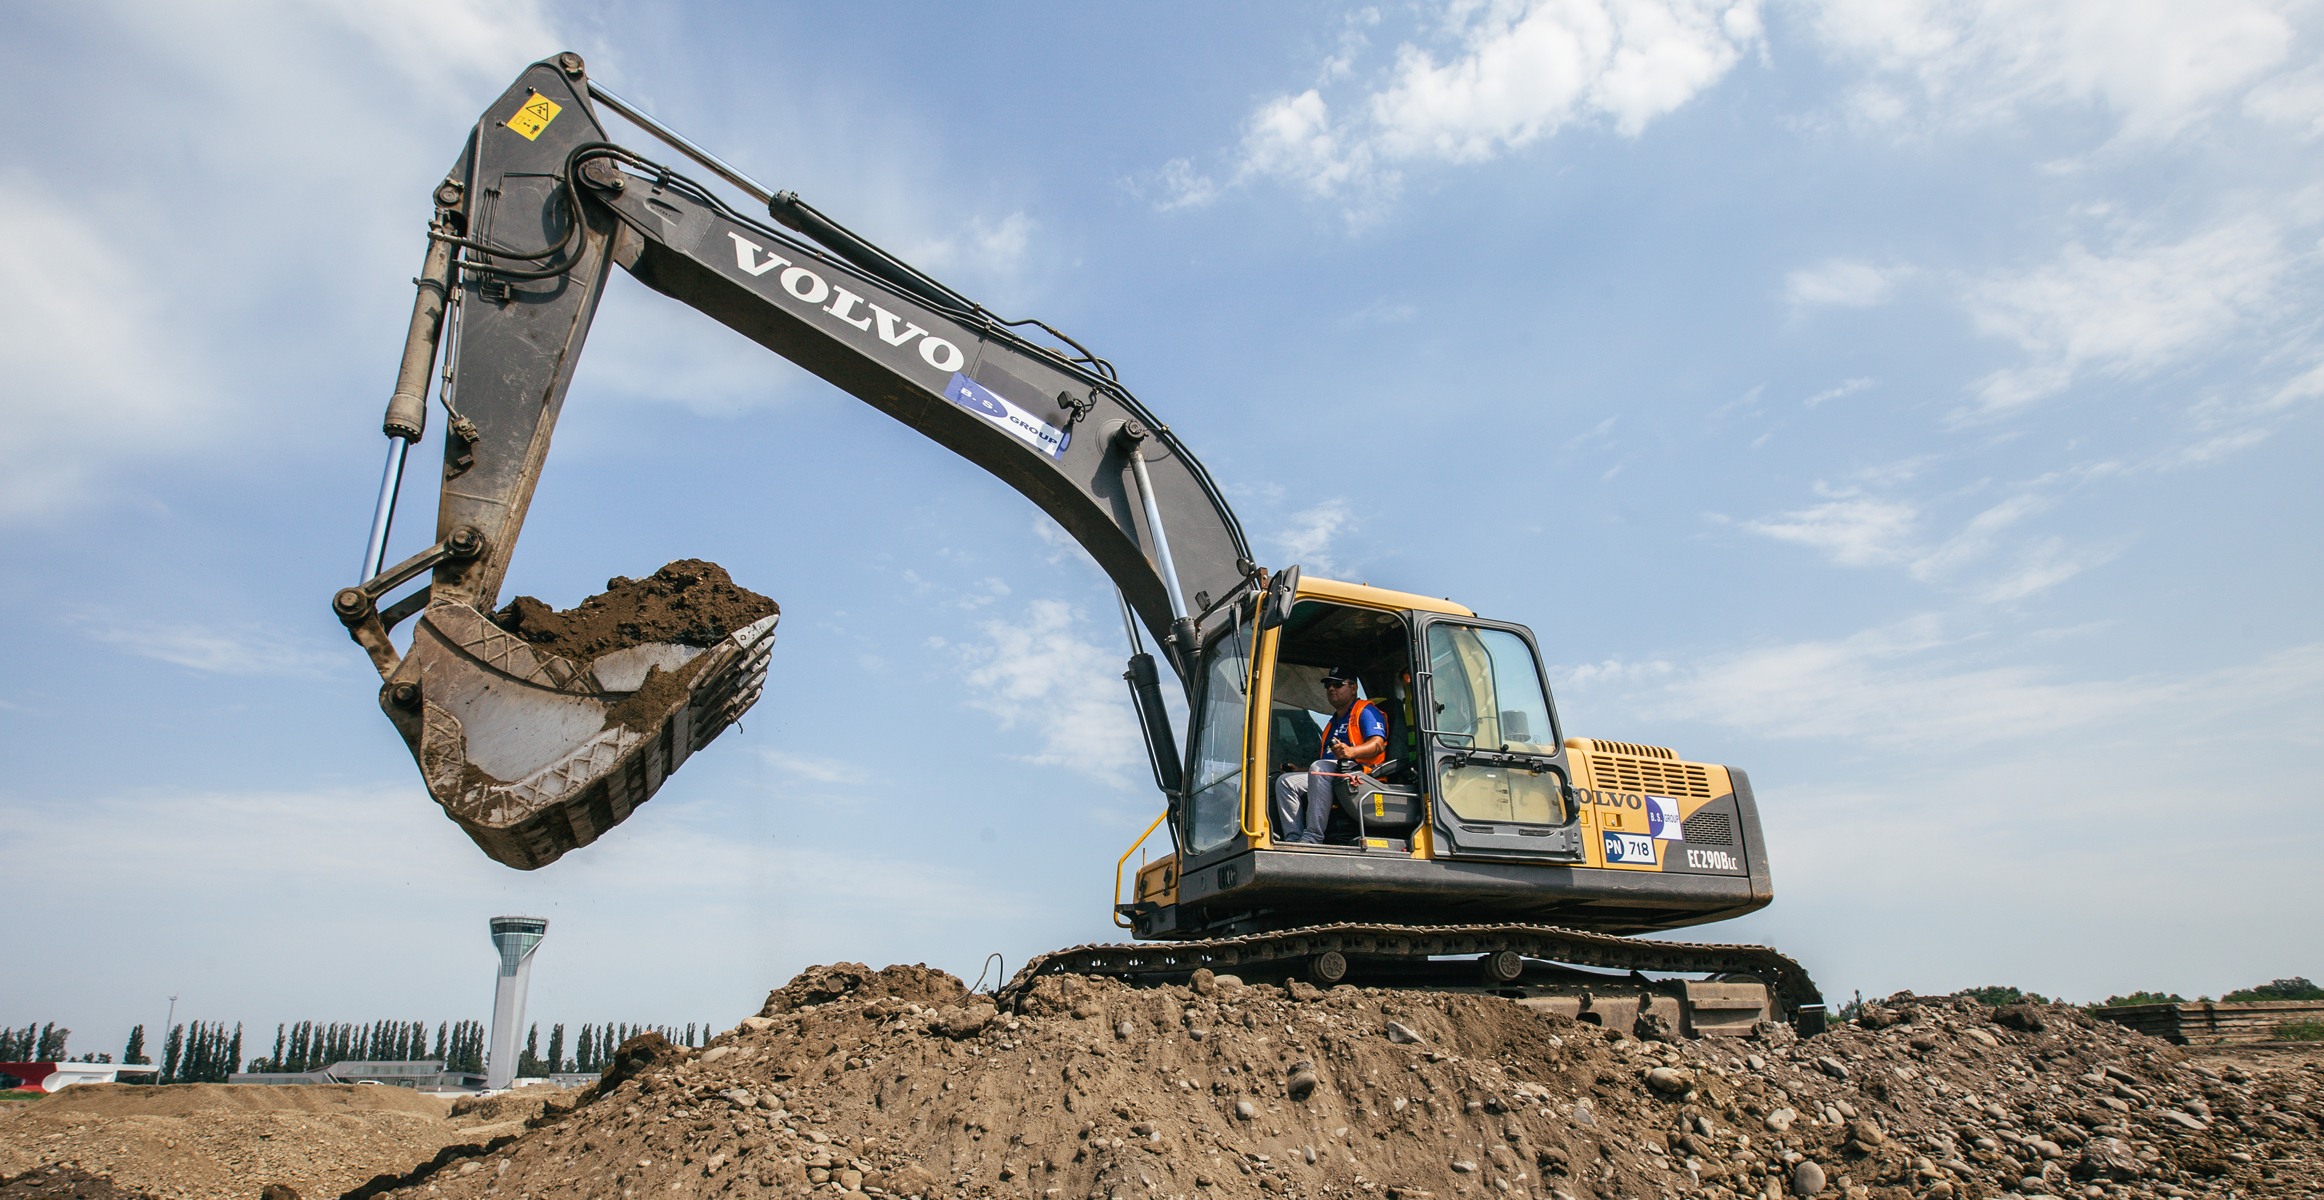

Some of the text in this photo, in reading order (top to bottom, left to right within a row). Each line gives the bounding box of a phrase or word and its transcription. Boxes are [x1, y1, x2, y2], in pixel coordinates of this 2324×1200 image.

[727, 231, 965, 373] VOLVO
[1009, 415, 1058, 445] GROUP
[1578, 787, 1642, 810] OLVO
[1664, 814, 1679, 823] GROUP
[1605, 839, 1650, 856] PN 718
